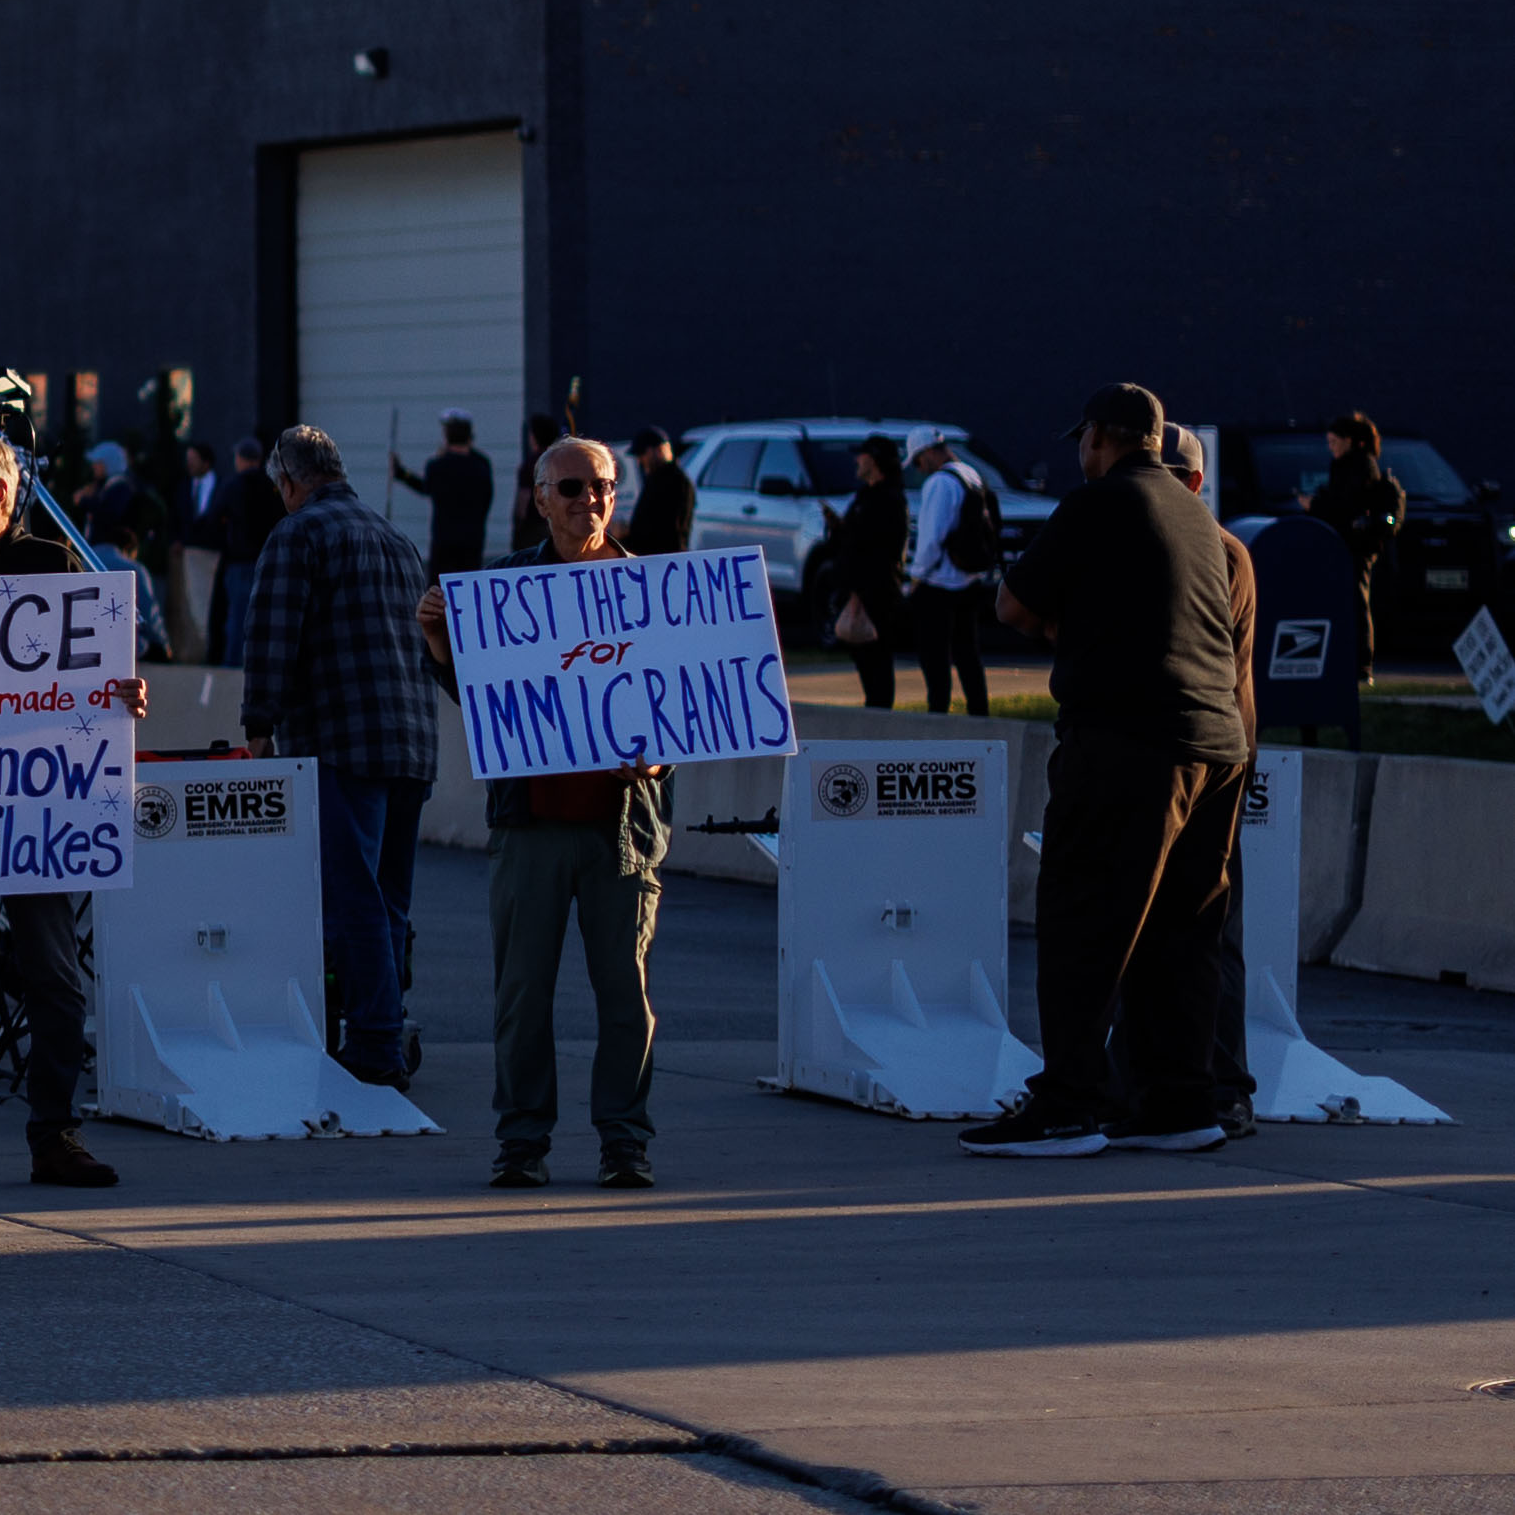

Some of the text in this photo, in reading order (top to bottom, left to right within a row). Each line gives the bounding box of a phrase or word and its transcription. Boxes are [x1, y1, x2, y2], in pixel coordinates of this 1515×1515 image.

[446, 554, 765, 654] FIRST THEY CAME
[560, 640, 634, 671] for
[88, 679, 121, 710] of
[466, 653, 789, 774] IMMIGRANTS
[877, 762, 976, 774] COOK COUNTY
[185, 779, 285, 794] COOK COUNTY
[877, 774, 977, 801] EMRS
[185, 792, 286, 821] EMRS
